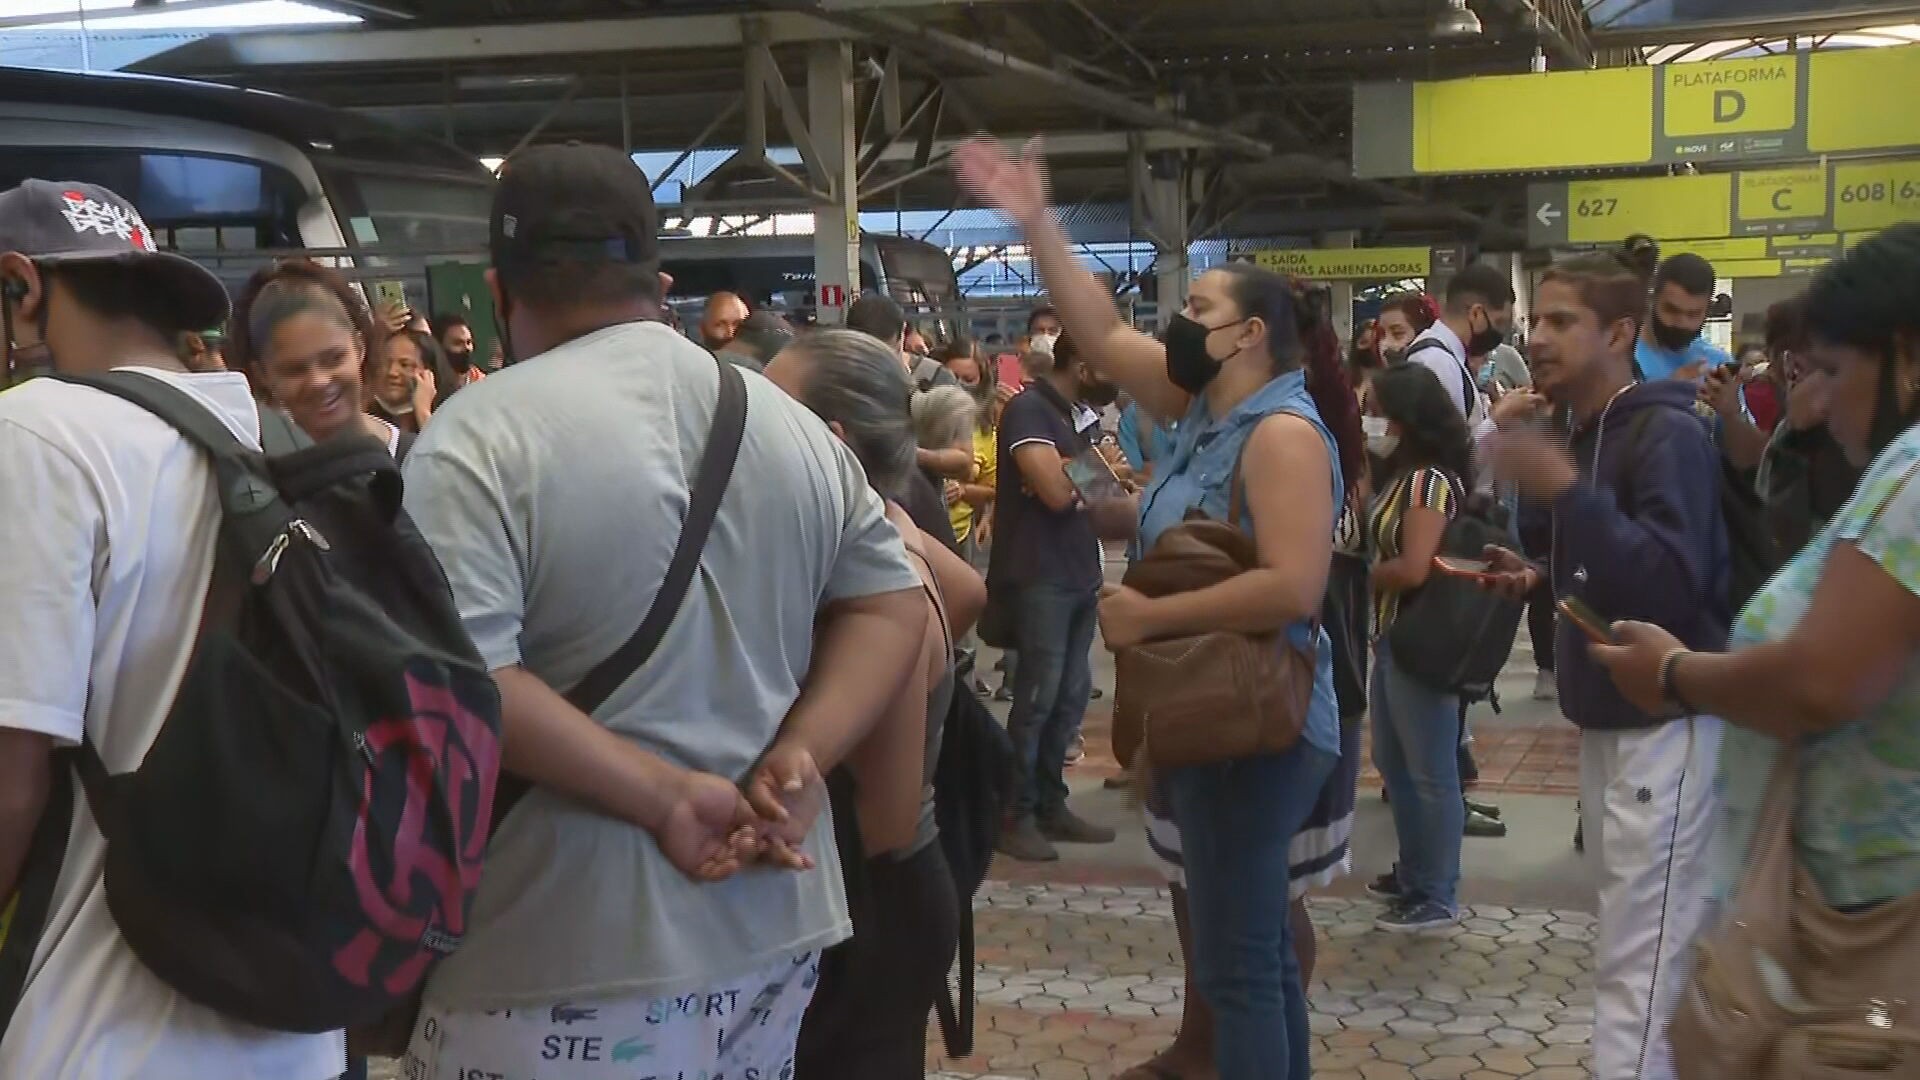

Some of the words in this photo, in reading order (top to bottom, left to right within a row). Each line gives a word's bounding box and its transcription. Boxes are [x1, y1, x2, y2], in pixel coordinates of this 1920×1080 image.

[1673, 67, 1787, 87] PLATAFORMA
[1713, 89, 1746, 123] D
[1771, 188, 1793, 211] C
[1840, 182, 1886, 203] 608
[1577, 198, 1618, 217] 627
[1318, 262, 1423, 276] ALIMENTADORAS
[645, 988, 741, 1025] SPORT
[540, 1034, 603, 1062] STE
